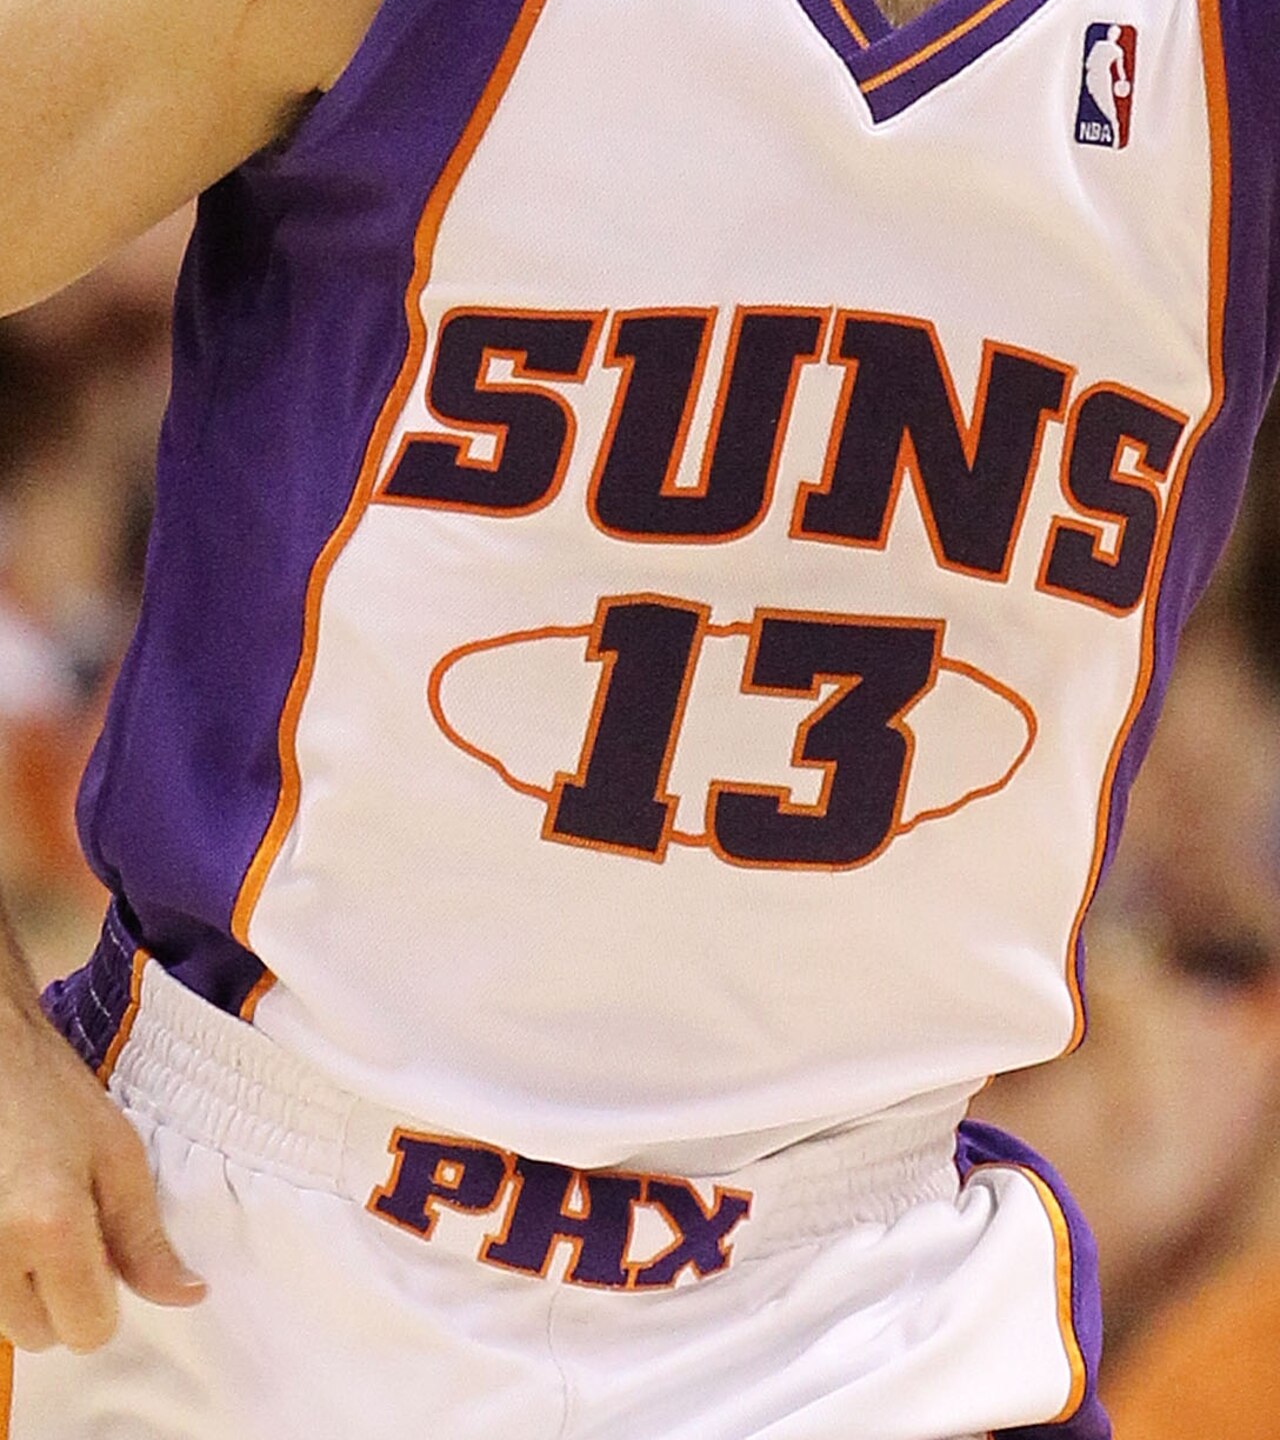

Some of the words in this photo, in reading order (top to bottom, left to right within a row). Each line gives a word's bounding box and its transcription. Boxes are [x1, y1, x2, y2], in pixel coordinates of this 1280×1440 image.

[1079, 121, 1113, 143] NBA
[372, 305, 1190, 618] SUNS
[541, 592, 946, 872] 13
[365, 1125, 754, 1293] PHX
